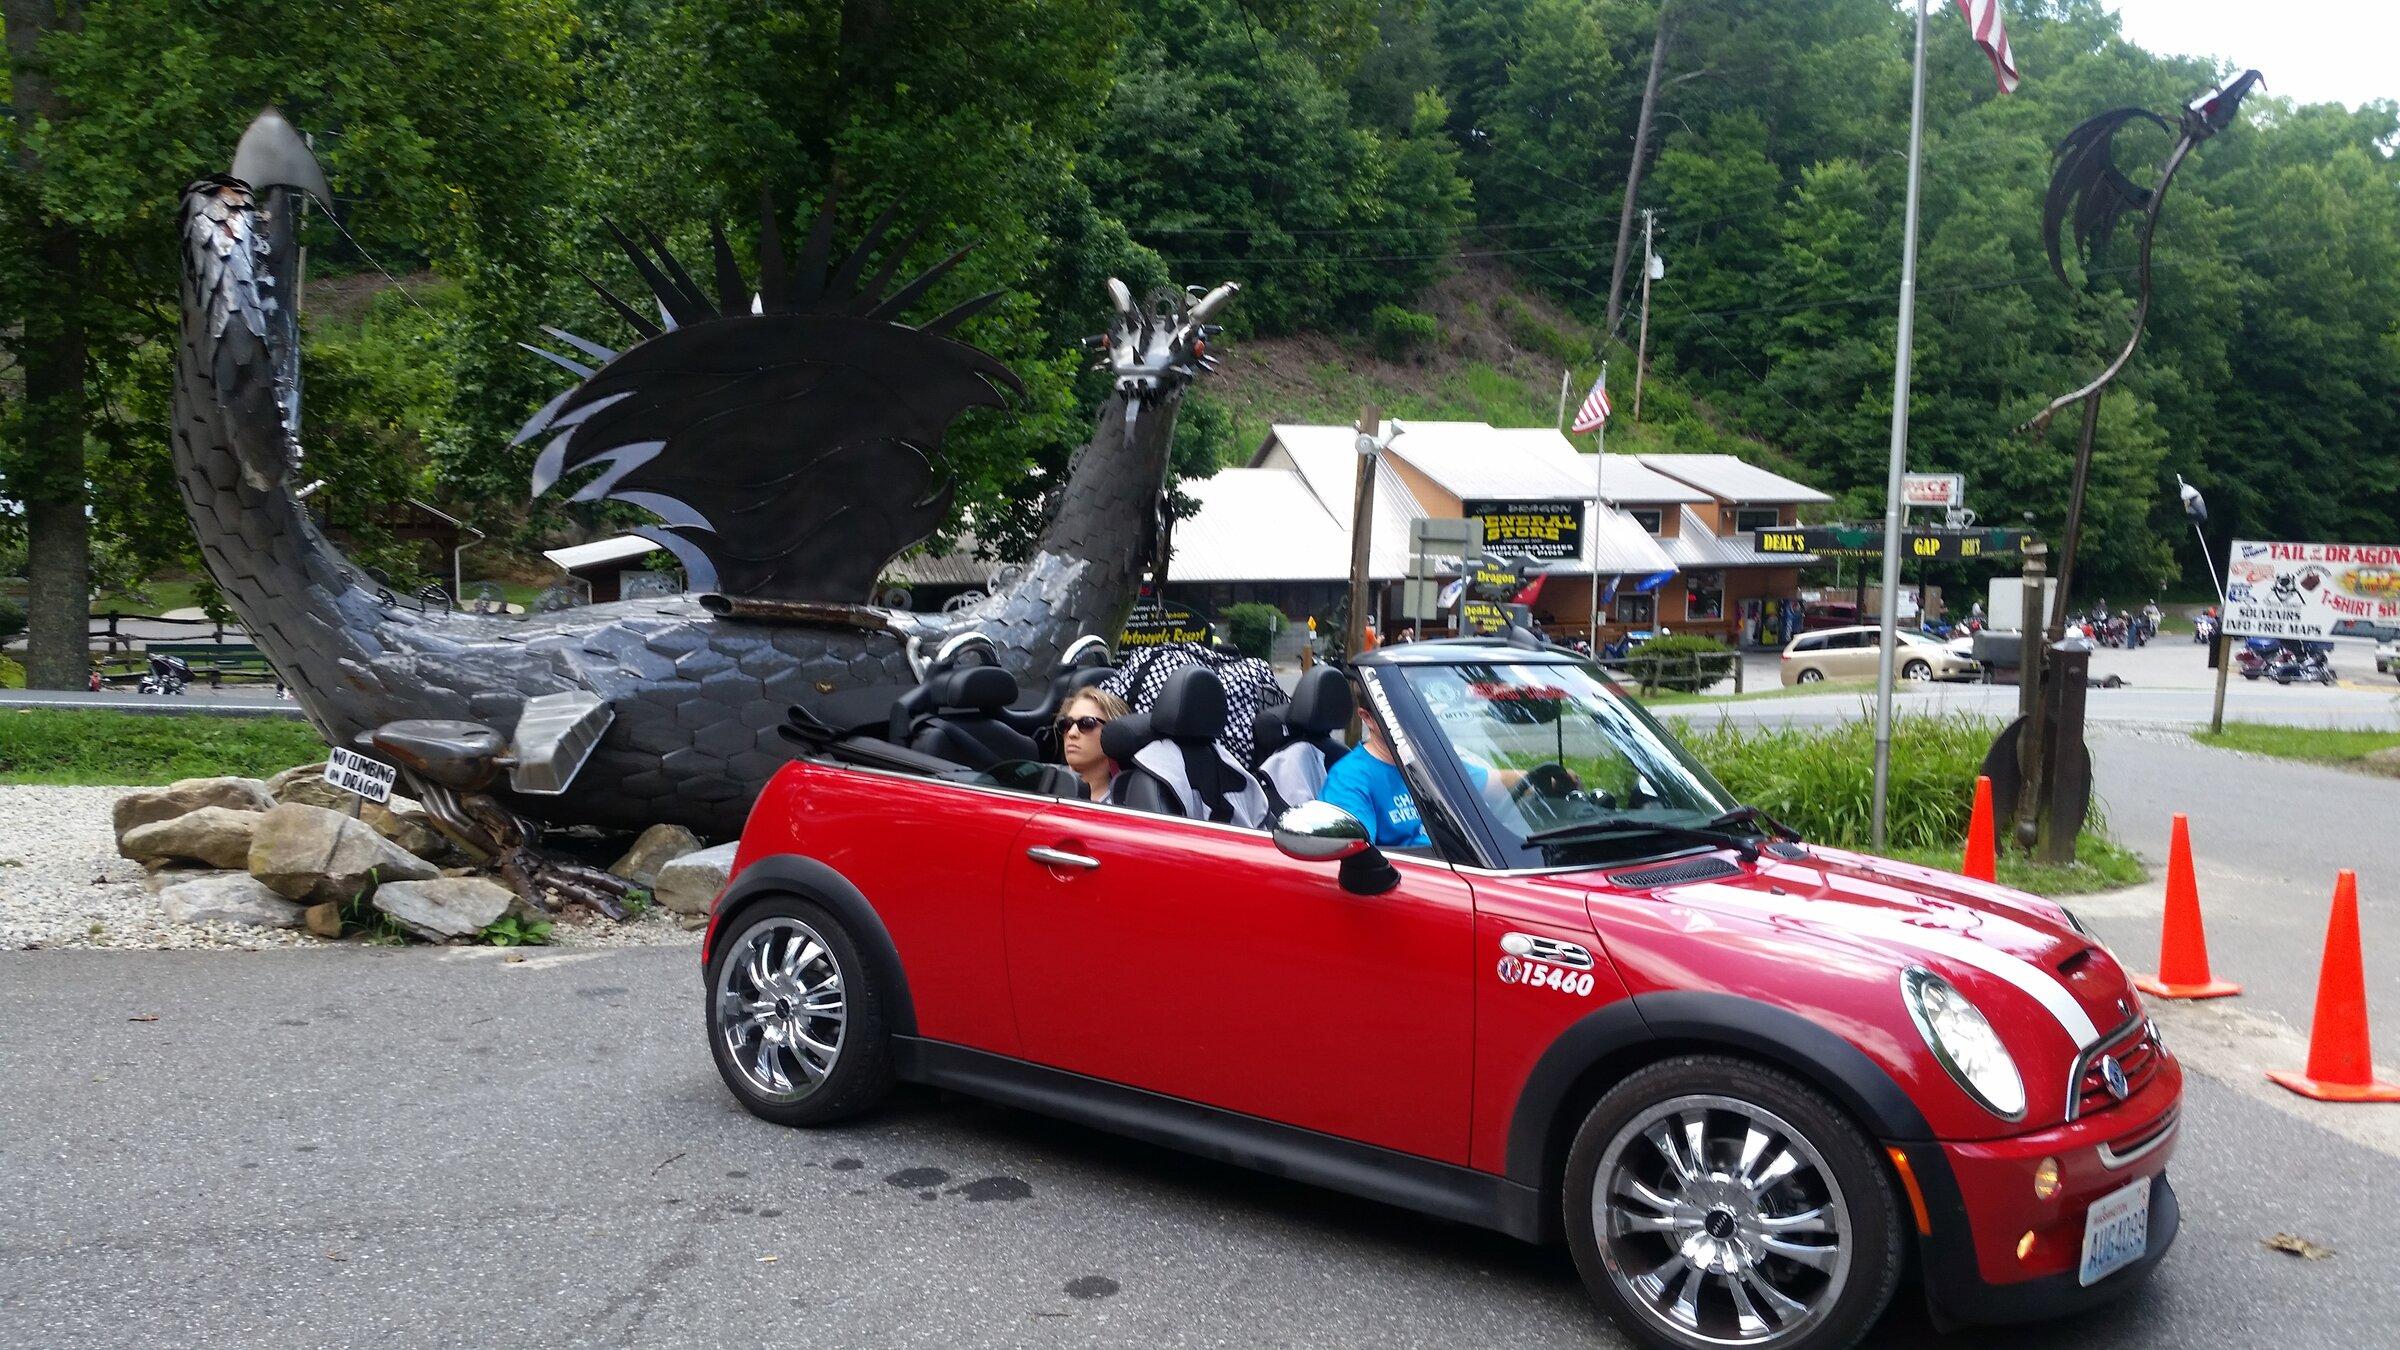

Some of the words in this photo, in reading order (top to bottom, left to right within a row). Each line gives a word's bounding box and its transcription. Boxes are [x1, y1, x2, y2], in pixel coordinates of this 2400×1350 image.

[1472, 515, 1576, 530] ENERAL
[1487, 527, 1559, 540] STORE
[1763, 533, 1805, 552] DEAL'S
[1913, 537, 1941, 556] GAP
[2269, 544, 2304, 560] TAIL
[1486, 563, 1499, 571] The
[1476, 570, 1516, 585] Dragon
[2239, 608, 2301, 621] SOUVENIRS
[2289, 623, 2322, 636] MAPS
[333, 748, 347, 765] NO
[348, 754, 394, 783] CLIMBING
[342, 771, 385, 800] DRAGON
[1520, 961, 1595, 997] 15460
